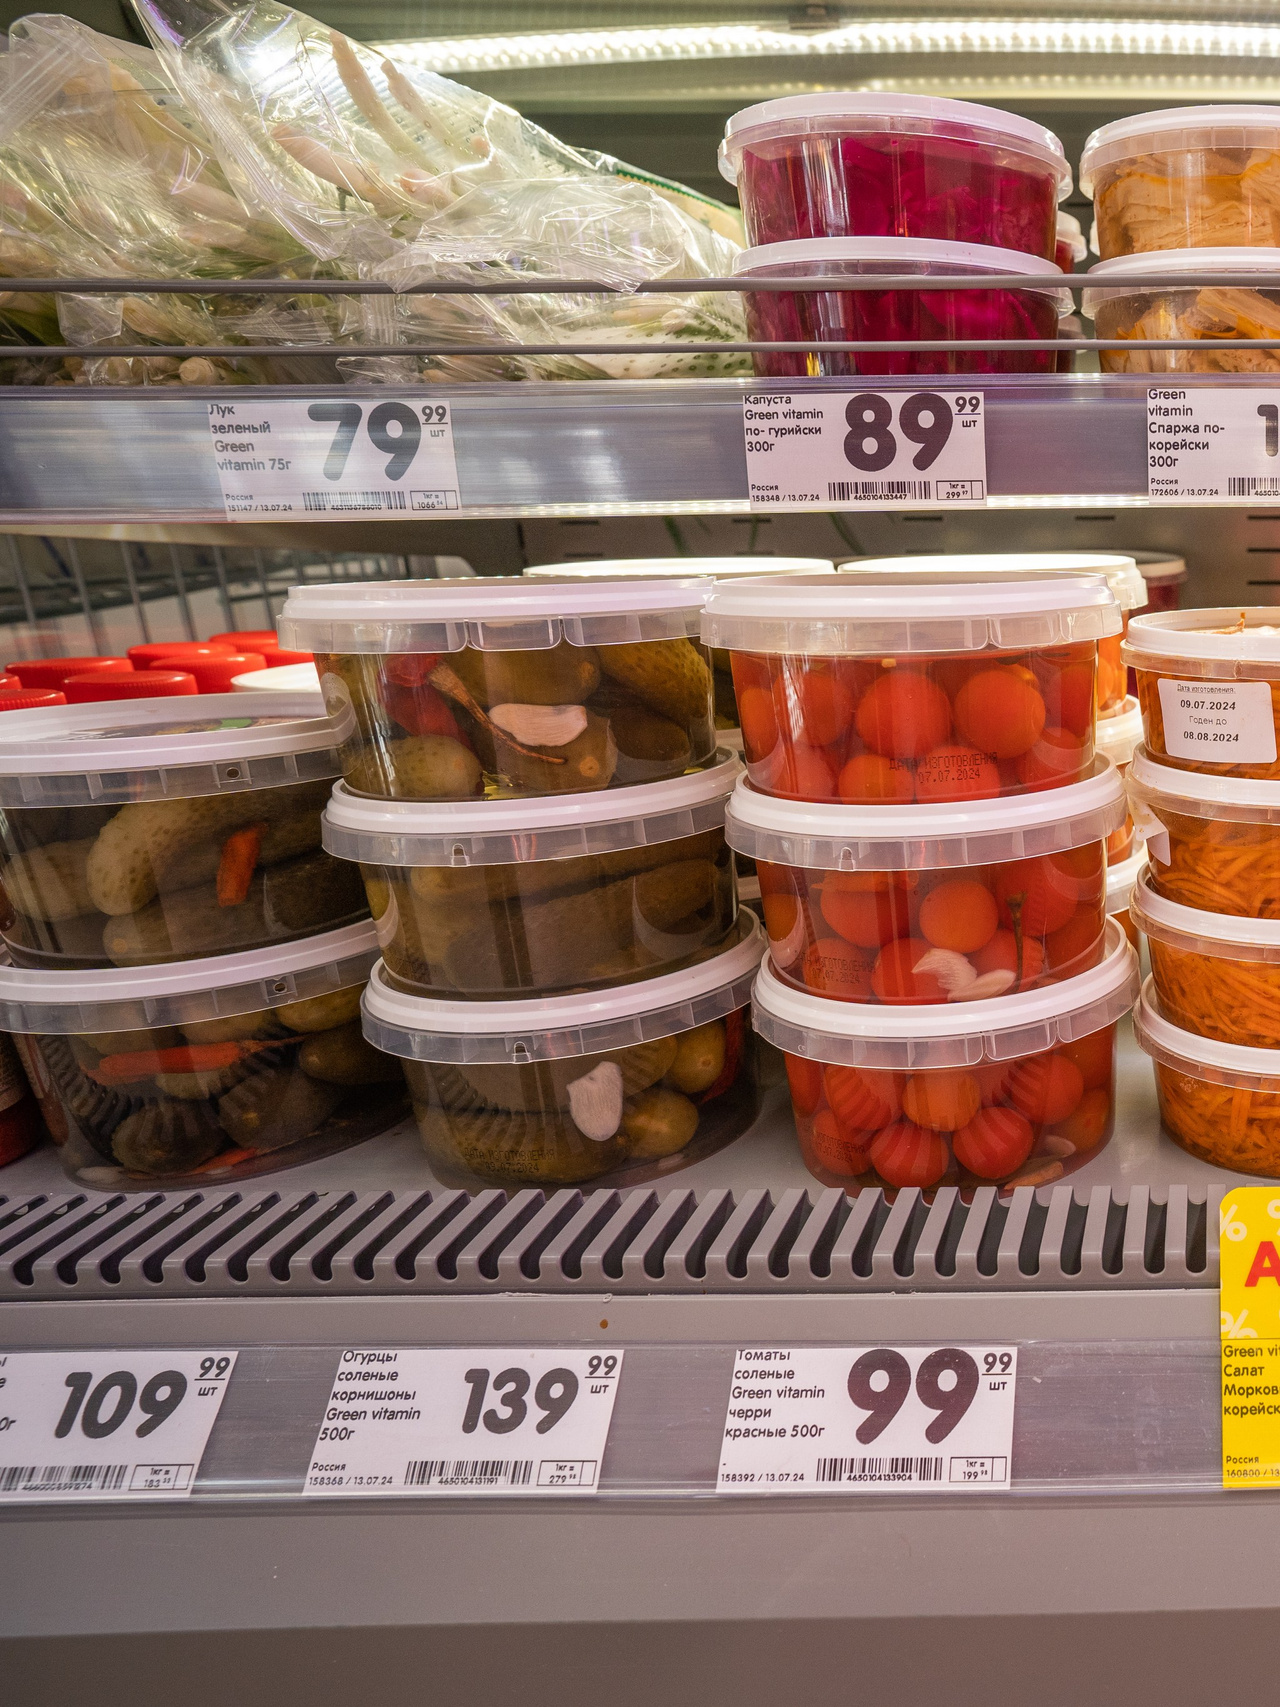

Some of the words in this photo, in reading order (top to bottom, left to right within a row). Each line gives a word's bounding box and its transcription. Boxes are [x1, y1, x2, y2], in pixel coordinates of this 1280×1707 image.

[744, 395, 791, 405] Капуста
[1149, 389, 1185, 399] Green
[209, 404, 235, 418] Лук
[745, 410, 779, 420] Green
[782, 409, 823, 419] vitamin
[1149, 406, 1193, 416] vitamin
[212, 421, 271, 433] зеленый
[746, 428, 764, 436] по-
[769, 425, 821, 437] гурийски
[844, 393, 953, 472] 89
[955, 396, 980, 413] 99
[1149, 422, 1199, 435] Спаржа
[1204, 424, 1225, 433] по-
[214, 441, 254, 452] Green
[307, 402, 422, 481] 79
[422, 405, 447, 422] 99
[747, 442, 774, 452] 300г
[1149, 440, 1209, 452] корейски
[217, 459, 265, 471] vitamin
[269, 459, 291, 470] 75г
[1149, 457, 1178, 467] 300г
[1180, 700, 1236, 711] 09.07.2024
[1189, 715, 1213, 726] Годен
[1183, 731, 1239, 743] 08.08.2024
[343, 1351, 397, 1363] Огурцы
[1224, 1345, 1263, 1357] Green
[338, 1370, 398, 1381] соленые
[735, 1369, 794, 1379] соленые
[1224, 1364, 1264, 1377] Салат
[198, 1387, 217, 1396] шт
[591, 1384, 609, 1394] шт
[989, 1381, 1007, 1391] шт
[54, 1370, 187, 1439] 109
[199, 1357, 230, 1378] 99
[331, 1389, 416, 1402] корнишоны
[462, 1368, 579, 1434] 139
[588, 1356, 617, 1376] 99
[732, 1387, 771, 1399] Green
[777, 1386, 825, 1398] vitamin
[848, 1348, 979, 1444] 99
[983, 1353, 1012, 1373] 99
[327, 1408, 366, 1420] Green
[372, 1408, 420, 1420] vitamin
[729, 1408, 771, 1421] черри
[319, 1427, 354, 1441] 500г
[725, 1427, 786, 1440] красные
[791, 1425, 825, 1438] 500г
